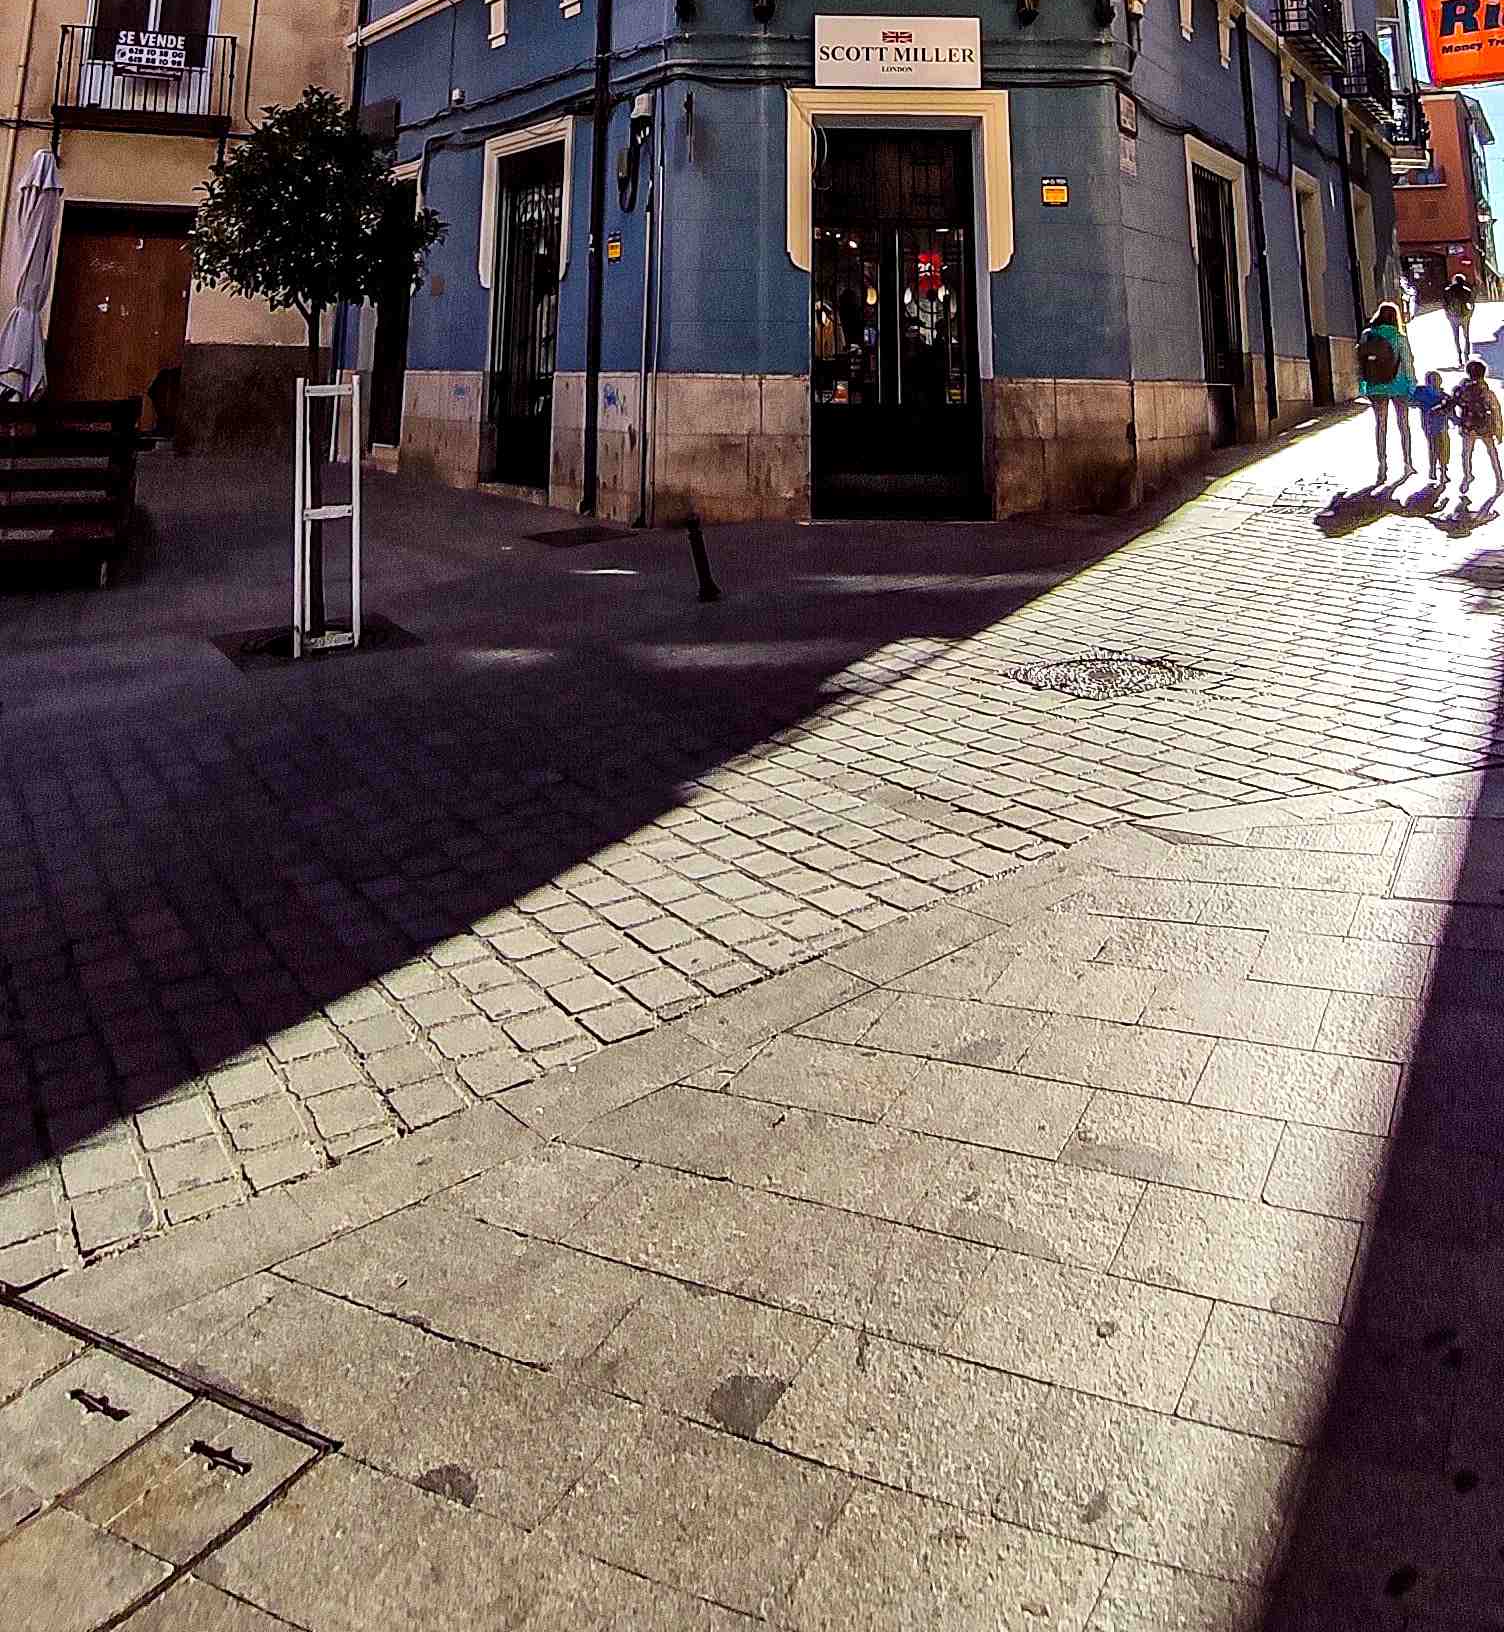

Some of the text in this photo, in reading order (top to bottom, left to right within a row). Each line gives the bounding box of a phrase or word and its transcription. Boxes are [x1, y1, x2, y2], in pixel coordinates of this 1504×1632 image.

[118, 30, 186, 50] SE VENDE
[819, 45, 975, 63] SCOTT MILLER
[1441, 42, 1483, 55] Money
[881, 65, 914, 73] LONDON
